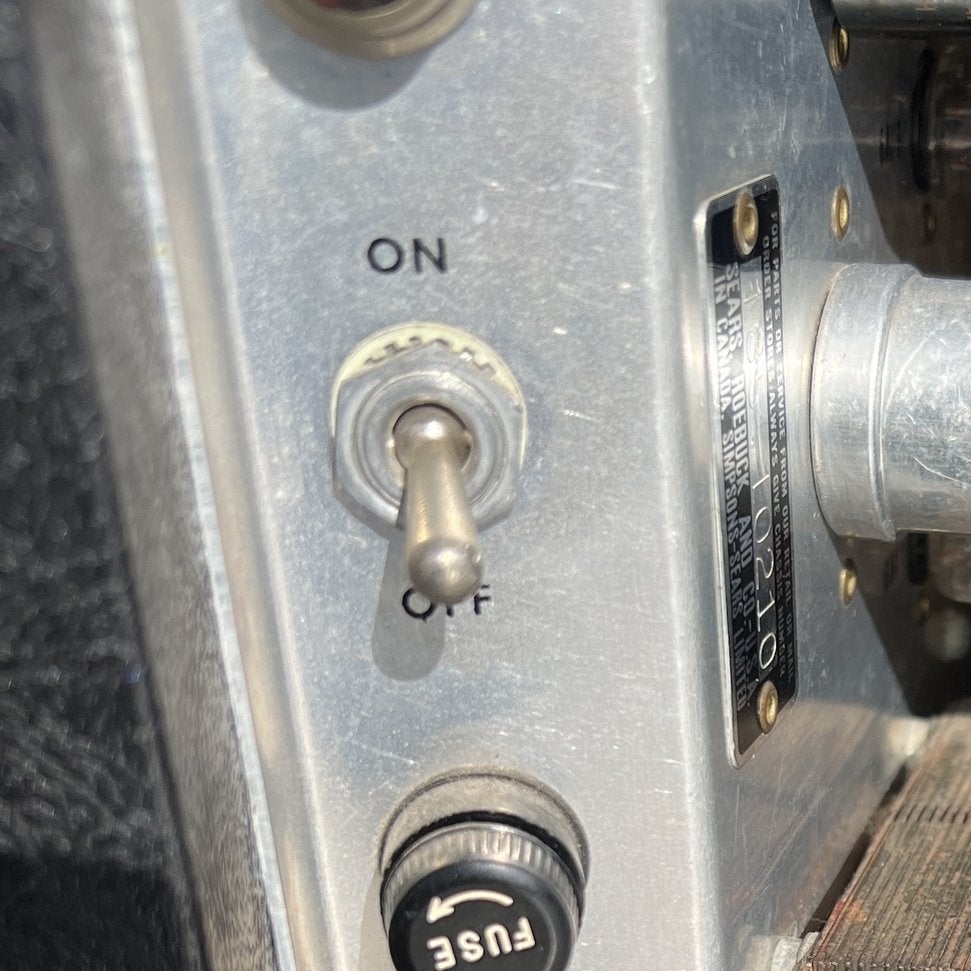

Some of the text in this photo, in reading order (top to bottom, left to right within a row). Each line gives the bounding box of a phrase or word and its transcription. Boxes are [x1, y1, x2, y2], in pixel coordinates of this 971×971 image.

[367, 237, 447, 274] ON
[770, 210, 780, 250] FOR
[762, 235, 772, 301] ORDER
[772, 258, 782, 320] PARTS
[774, 329, 783, 355] OR
[731, 374, 750, 497] ROEBUCK
[769, 392, 779, 467] ALWAYS
[715, 276, 727, 304] IN
[722, 430, 744, 619] SIMPSONS-SEARS
[733, 627, 748, 712] LIMITED
[772, 474, 781, 516] GIVE
[779, 447, 788, 497] FROM
[738, 516, 754, 568] AND
[782, 505, 790, 542] OUR
[773, 524, 784, 598] CHASSIS
[783, 548, 792, 607] RETAIL
[402, 584, 491, 620] OF
[785, 613, 793, 637] OR
[786, 642, 794, 684] MAIL
[427, 916, 536, 971] FUSE
